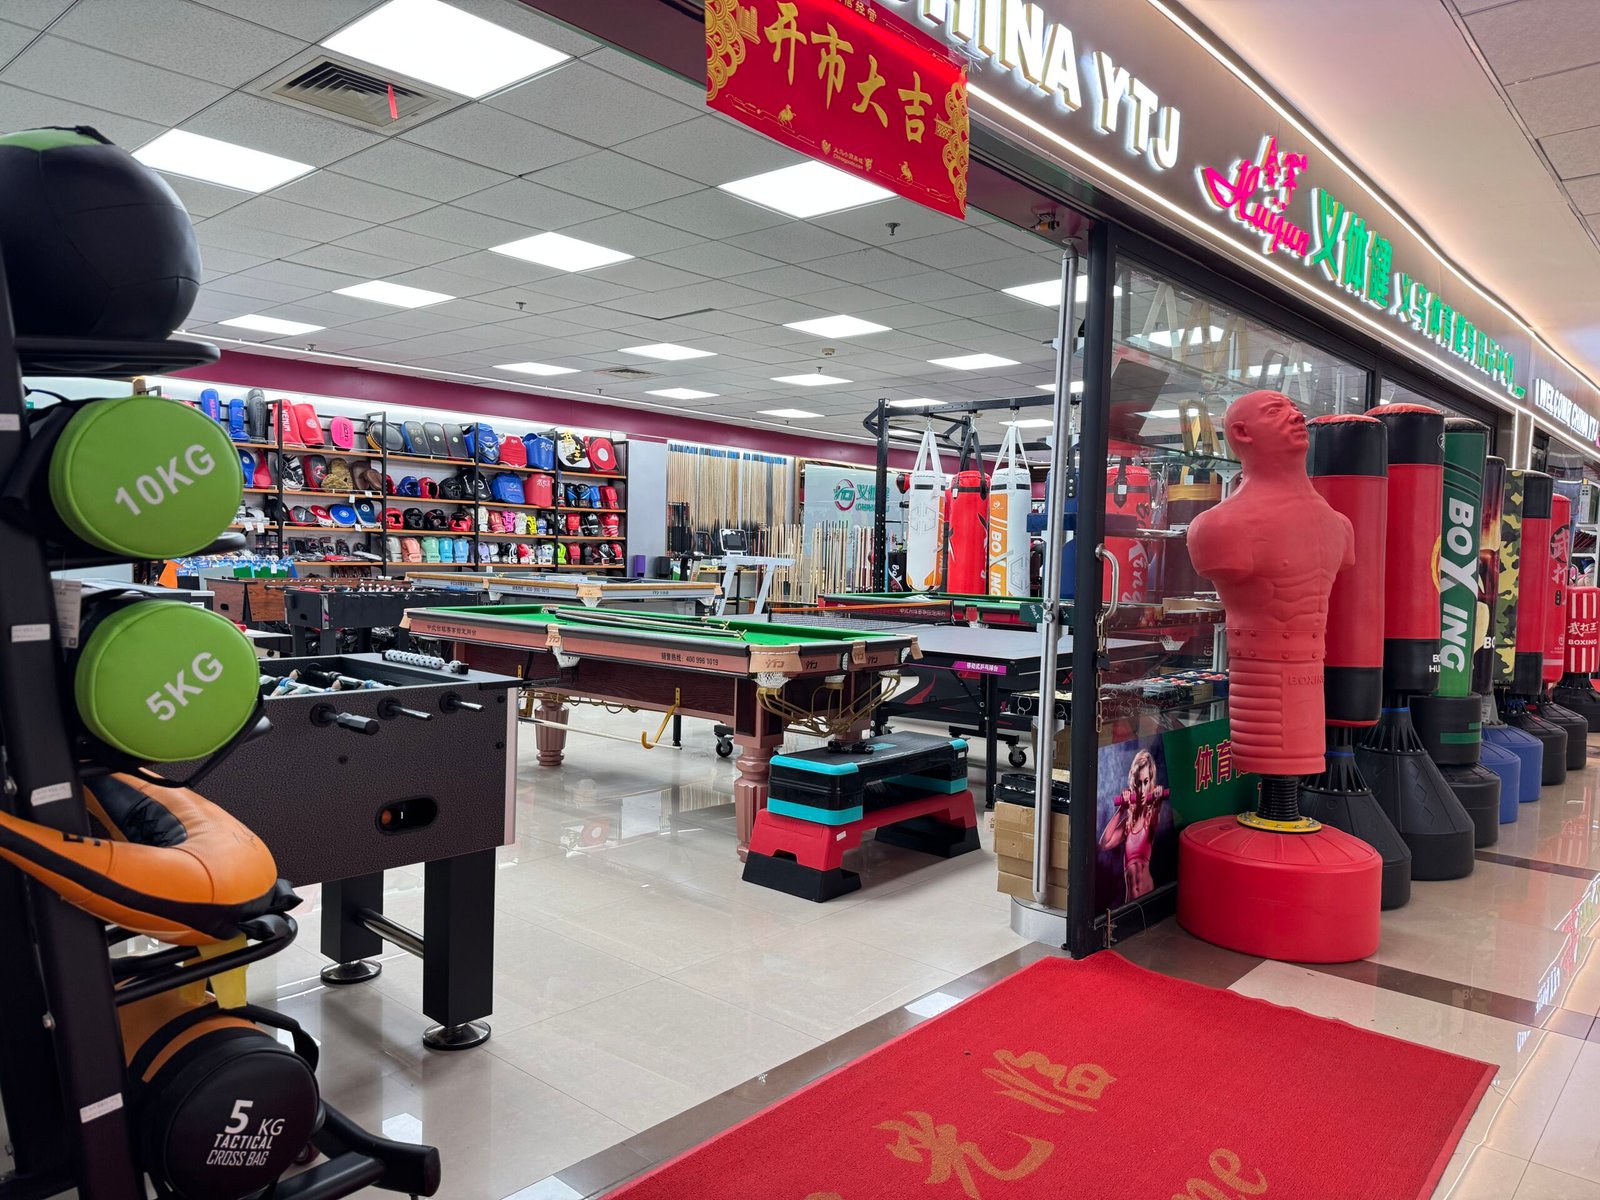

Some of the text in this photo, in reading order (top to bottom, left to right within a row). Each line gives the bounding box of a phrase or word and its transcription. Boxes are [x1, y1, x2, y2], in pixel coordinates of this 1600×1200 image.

[763, 1, 934, 143] 开市大吉
[1092, 50, 1181, 170] YTJ
[114, 443, 217, 517] 10KG
[1438, 496, 1479, 673] BOXING
[1568, 638, 1598, 646] BOXING
[145, 650, 225, 722] 5KG
[213, 1133, 273, 1150] TACTICAL
[224, 1099, 286, 1136] 5 KG
[873, 1048, 1117, 1200] 光临
[206, 1149, 270, 1167] CROSS BAG
